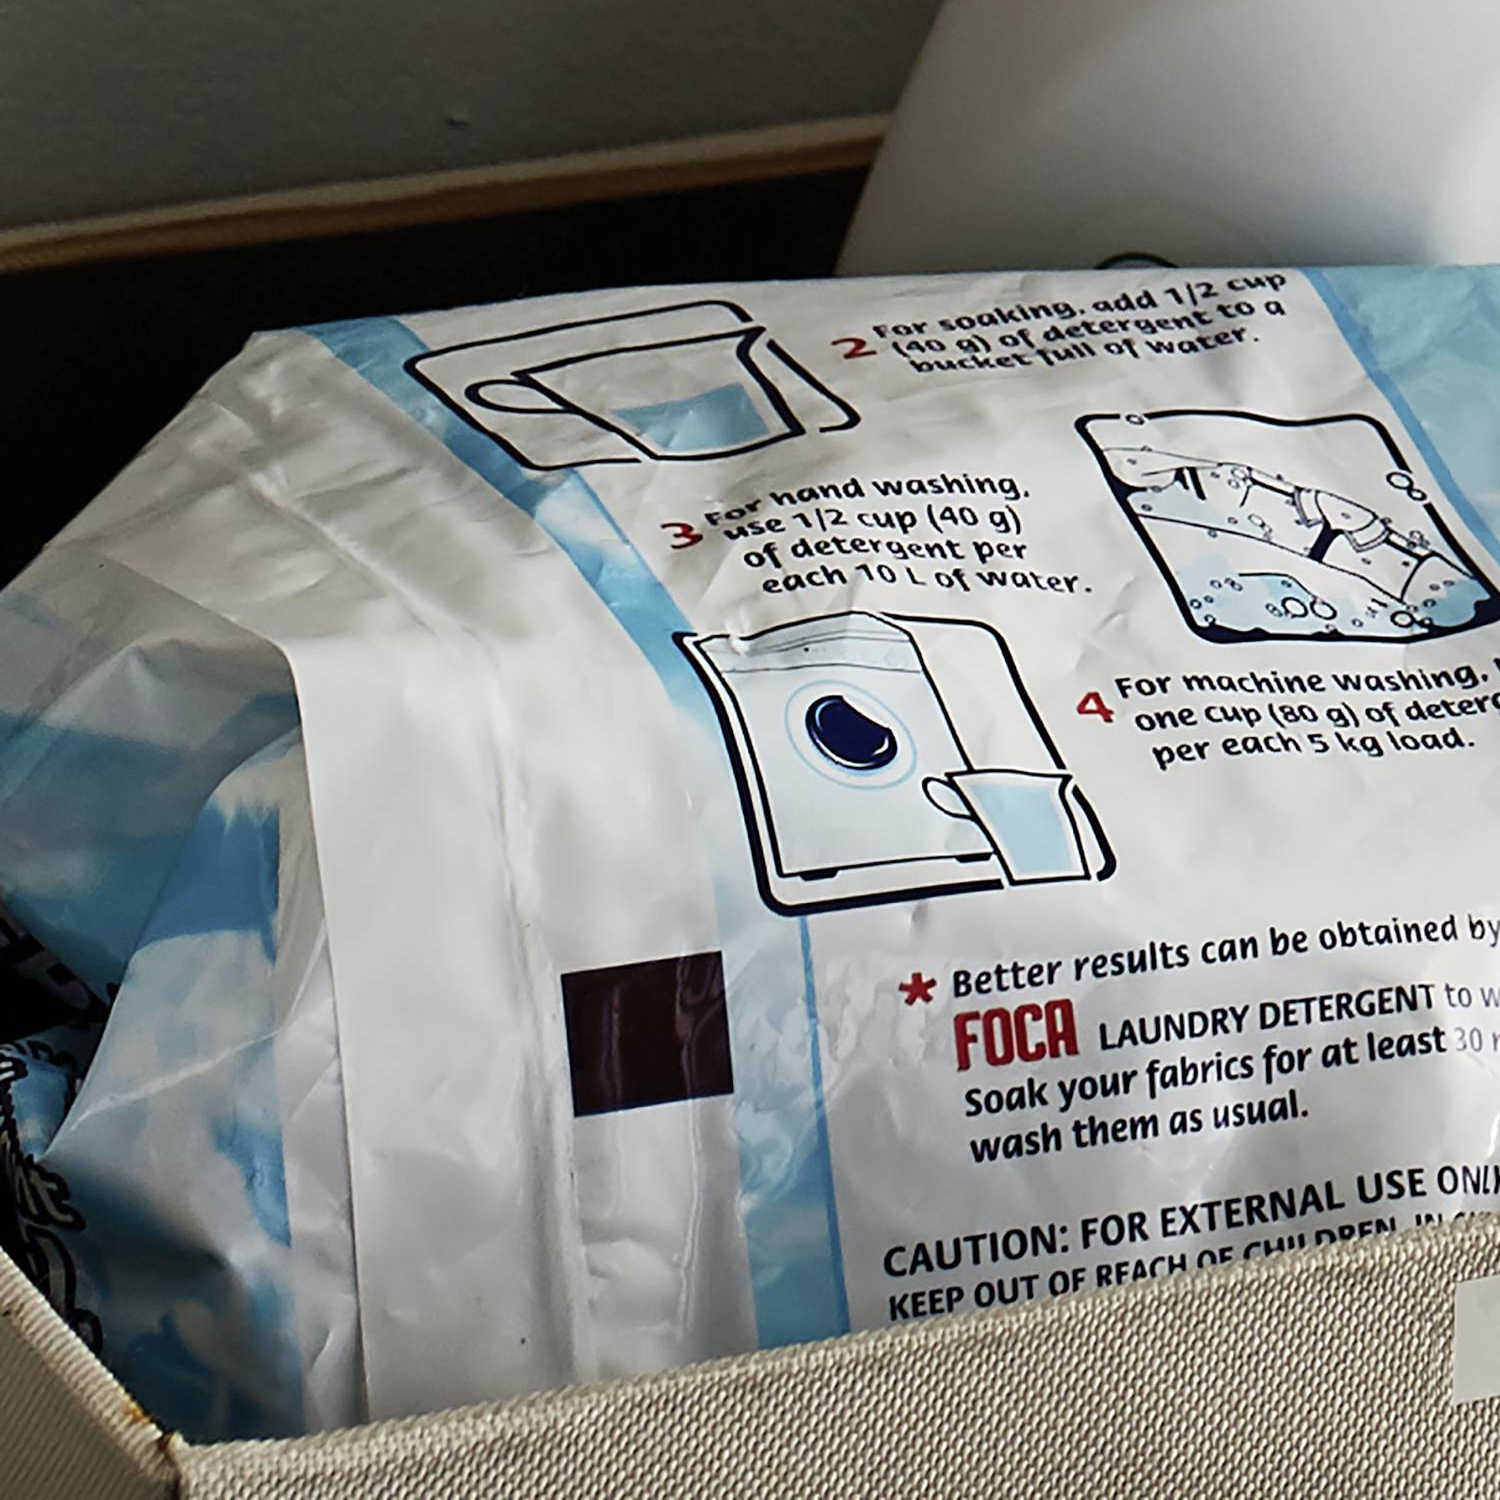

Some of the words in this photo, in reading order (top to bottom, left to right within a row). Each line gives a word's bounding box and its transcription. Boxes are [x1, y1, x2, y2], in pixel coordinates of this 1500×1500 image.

[831, 338, 879, 360] 2
[873, 320, 927, 341] For
[1092, 291, 1158, 313] add
[1164, 281, 1219, 305] 1/2
[1227, 273, 1287, 292] cup
[892, 338, 946, 361] (40
[955, 336, 991, 359] g)
[1000, 327, 1032, 348] of
[1043, 309, 1212, 343] detergent
[1217, 301, 1255, 317] to
[1265, 300, 1286, 317] a
[909, 353, 1031, 373] bucket
[1040, 343, 1096, 367] full
[1104, 338, 1139, 359] of
[1150, 327, 1259, 355] water.
[660, 522, 704, 549] 3
[705, 498, 762, 527] For
[769, 477, 865, 507] hand
[723, 518, 786, 541] use
[792, 507, 849, 532] 1/2
[857, 508, 918, 534] cup
[926, 503, 980, 532] (40
[988, 504, 1022, 536] g)
[743, 542, 780, 569] of
[790, 535, 966, 560] detergent
[972, 538, 1027, 562] per
[762, 563, 847, 594] each
[856, 563, 898, 584] 10
[906, 566, 927, 586] L
[934, 567, 971, 592] of
[976, 569, 1093, 594] water.
[1076, 691, 1114, 724] 4
[1115, 672, 1172, 700] For
[1182, 668, 1327, 695] machine
[1135, 705, 1195, 732] one
[1204, 705, 1263, 731] cup
[1268, 703, 1319, 730] (80
[1325, 702, 1363, 732] g)
[1365, 701, 1403, 728] of
[1153, 740, 1211, 770] per
[1221, 732, 1302, 757] each
[1310, 731, 1332, 754] 5
[1336, 730, 1386, 758] kg
[1390, 726, 1476, 753] load.
[953, 960, 1063, 998] Better
[1073, 941, 1191, 981] results
[1201, 933, 1259, 964] can
[1268, 926, 1309, 957] be
[1318, 914, 1458, 950] obtained
[953, 998, 1080, 1072] FOCA
[1099, 1004, 1251, 1051] LAUNDRY
[1258, 983, 1436, 1031] DETERGENT
[1444, 982, 1473, 1008] to
[1057, 1069, 1138, 1113] your
[1145, 1051, 1255, 1100] fabrics
[1262, 1044, 1313, 1085] for
[1321, 1037, 1360, 1068] at
[1366, 1025, 1448, 1065] least
[1453, 1027, 1484, 1052] 30
[969, 1122, 1063, 1163] wash
[1071, 1112, 1160, 1149] them
[1168, 1107, 1203, 1136] as
[1212, 1088, 1309, 1128] usual.
[883, 1223, 1070, 1277] CAUTION:
[1081, 1211, 1150, 1250] FOR
[1160, 1179, 1346, 1238] EXTERNAL
[1356, 1167, 1428, 1204] USE
[888, 1285, 965, 1322] KEEP
[973, 1273, 1040, 1308] OUT
[1048, 1267, 1087, 1297] OF
